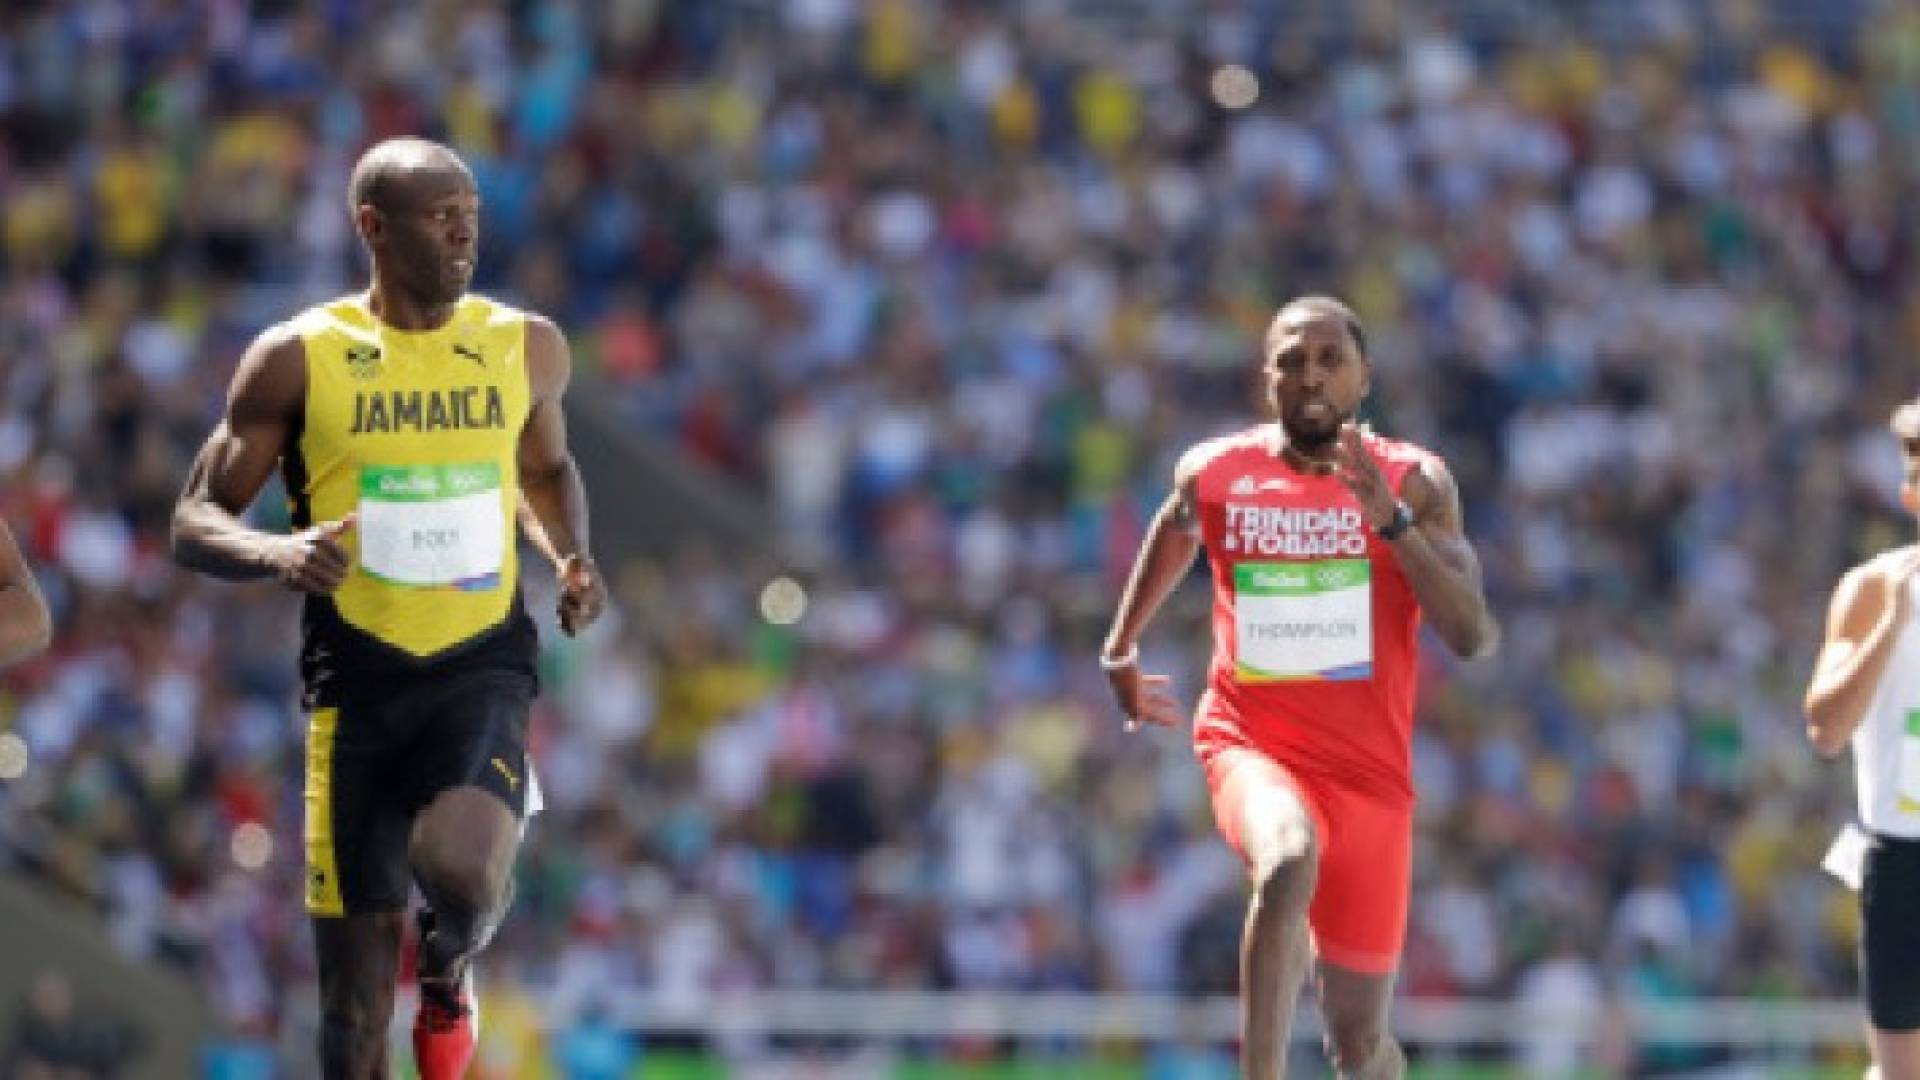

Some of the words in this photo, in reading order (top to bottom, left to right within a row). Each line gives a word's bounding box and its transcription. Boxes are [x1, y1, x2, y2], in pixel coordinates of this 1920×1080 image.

[350, 386, 505, 433] JAMAICA
[1226, 503, 1363, 535] TRINIDAD
[1243, 529, 1367, 554] TOBAGO
